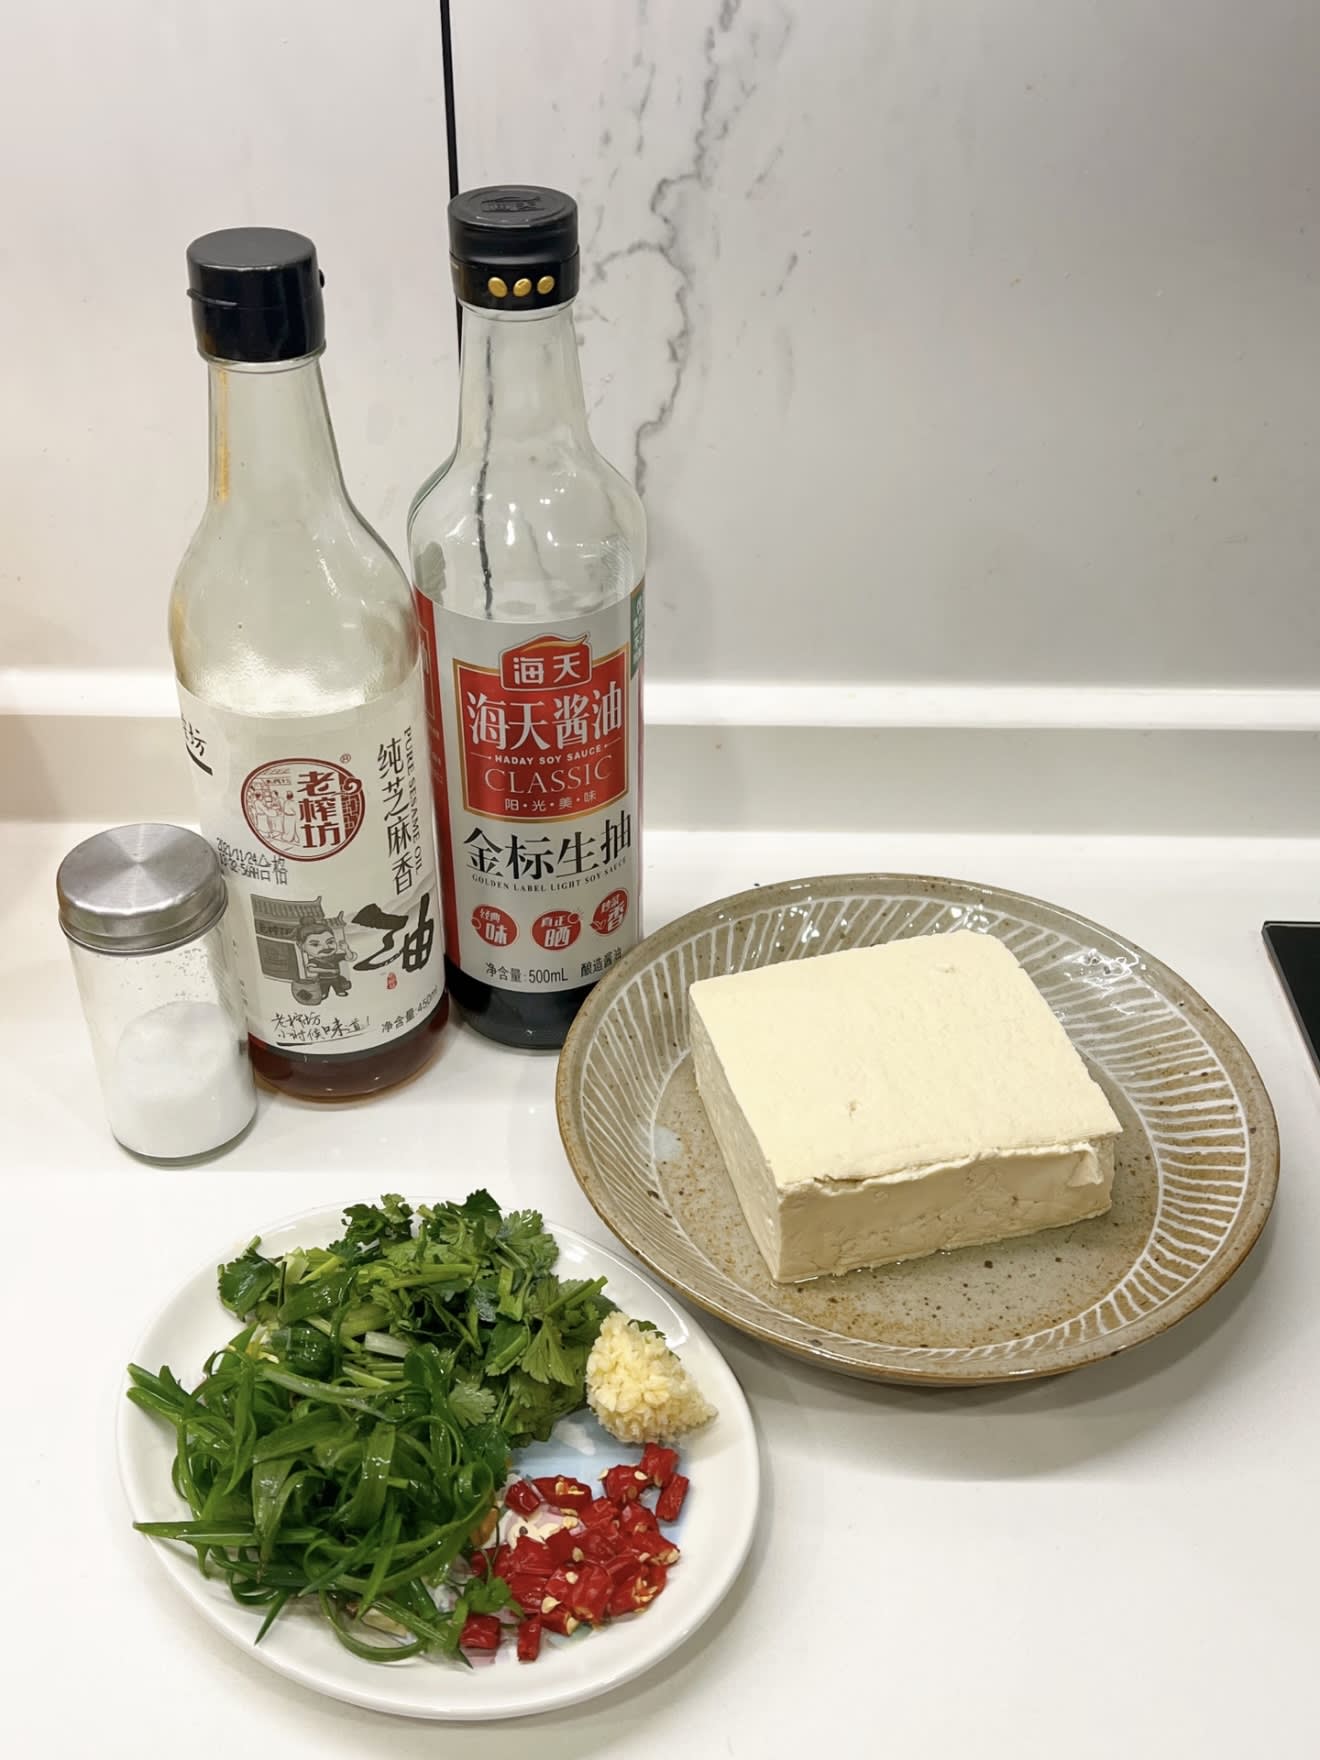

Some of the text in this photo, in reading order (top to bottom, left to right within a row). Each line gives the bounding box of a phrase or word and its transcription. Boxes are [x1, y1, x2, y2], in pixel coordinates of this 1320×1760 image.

[513, 652, 580, 685] 海天
[467, 681, 622, 750] 海天酱油
[495, 744, 602, 766] HADAY SOY SAUCE
[484, 755, 612, 794] CLASSIC
[297, 771, 341, 848] 老榨坊
[377, 737, 414, 895] 纯芝麻香
[404, 725, 423, 875] PURE SESAME OIL
[463, 810, 631, 880] 金标生抽
[472, 857, 627, 892] GOLDEN LABEL LIGHT SOY SAUCE
[485, 923, 508, 945] 味
[608, 901, 625, 931] 香
[544, 926, 571, 947] 晒
